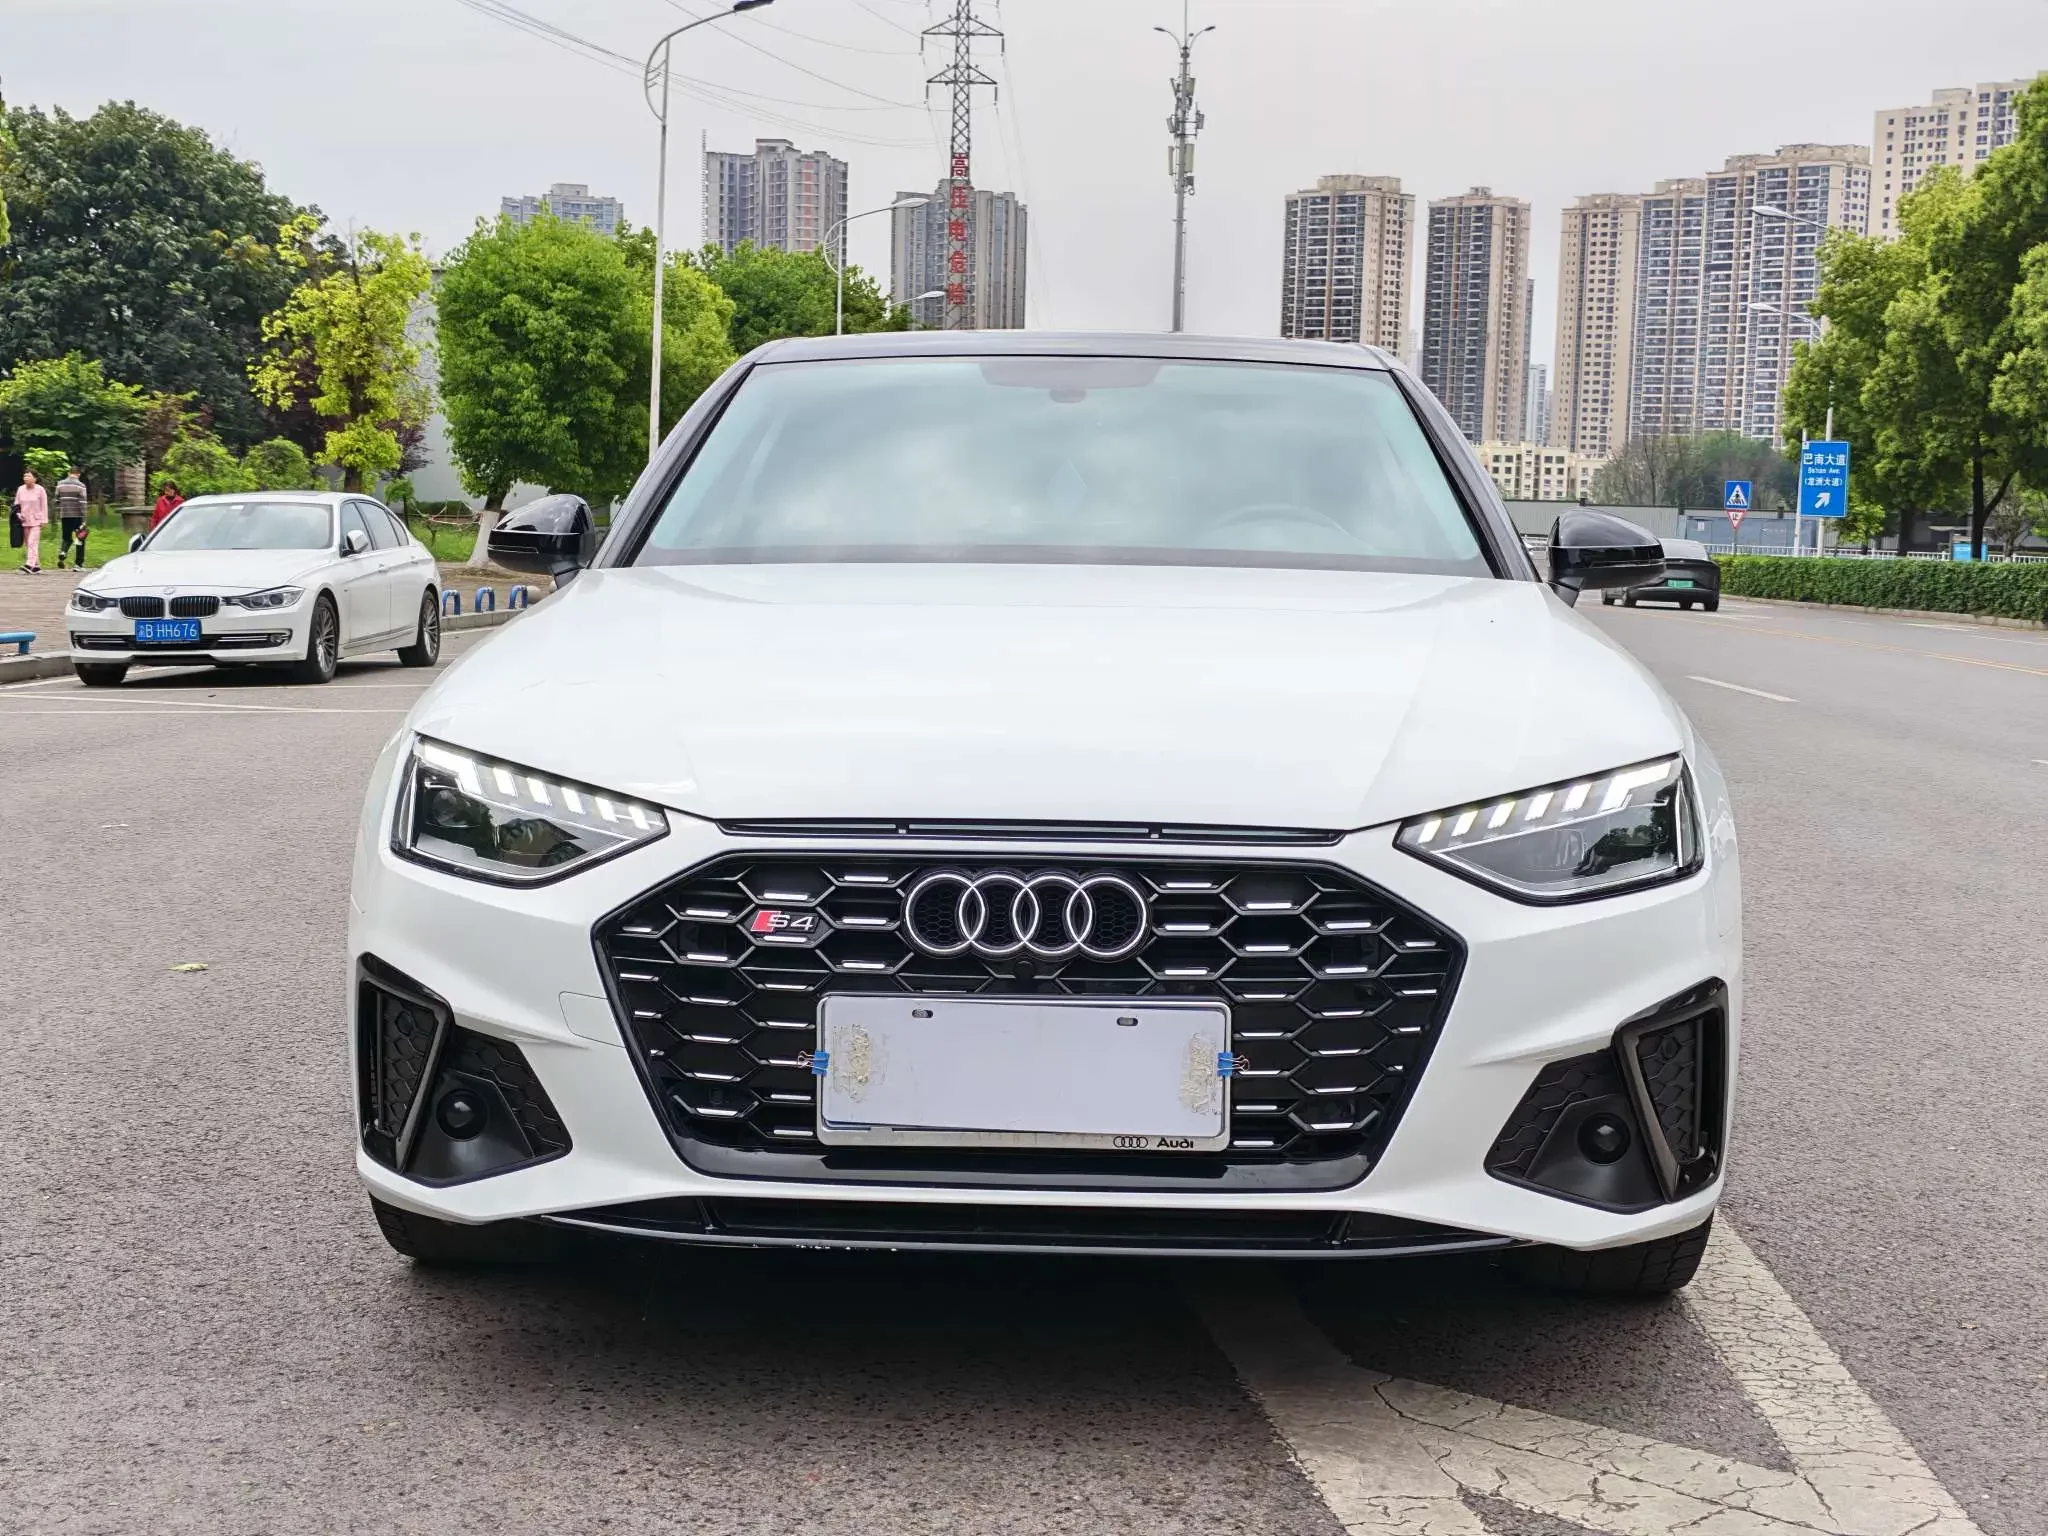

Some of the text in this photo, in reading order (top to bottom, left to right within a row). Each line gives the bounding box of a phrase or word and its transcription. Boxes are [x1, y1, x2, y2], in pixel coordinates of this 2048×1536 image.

[1803, 453, 1846, 466] 巴南大道
[767, 914, 814, 931] S4
[1157, 1136, 1194, 1149] Audi
